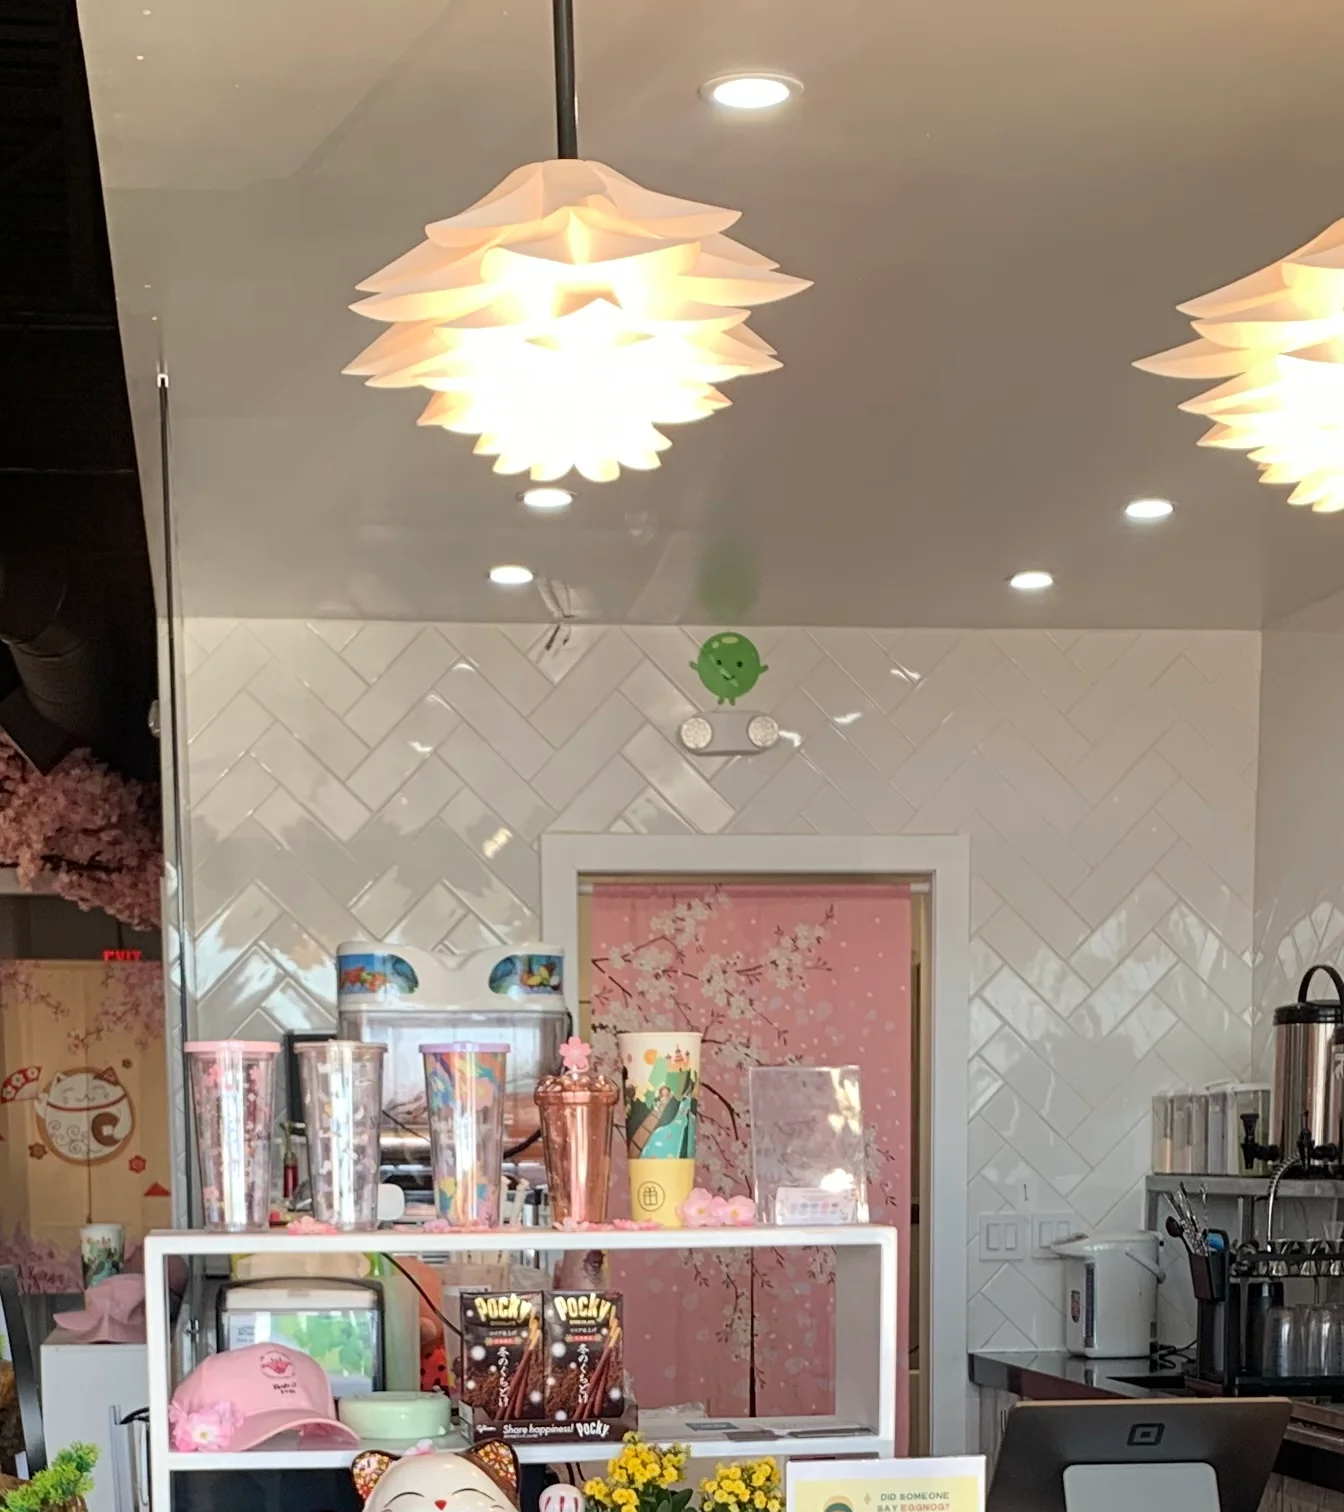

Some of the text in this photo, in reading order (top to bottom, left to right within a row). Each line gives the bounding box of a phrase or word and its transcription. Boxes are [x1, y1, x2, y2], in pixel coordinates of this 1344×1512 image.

[503, 1424, 528, 1434] Share
[529, 1423, 574, 1436] happiness!
[880, 1491, 950, 1501] DID SOMEONE
[877, 1503, 950, 1512] SAY EGGNOG?
